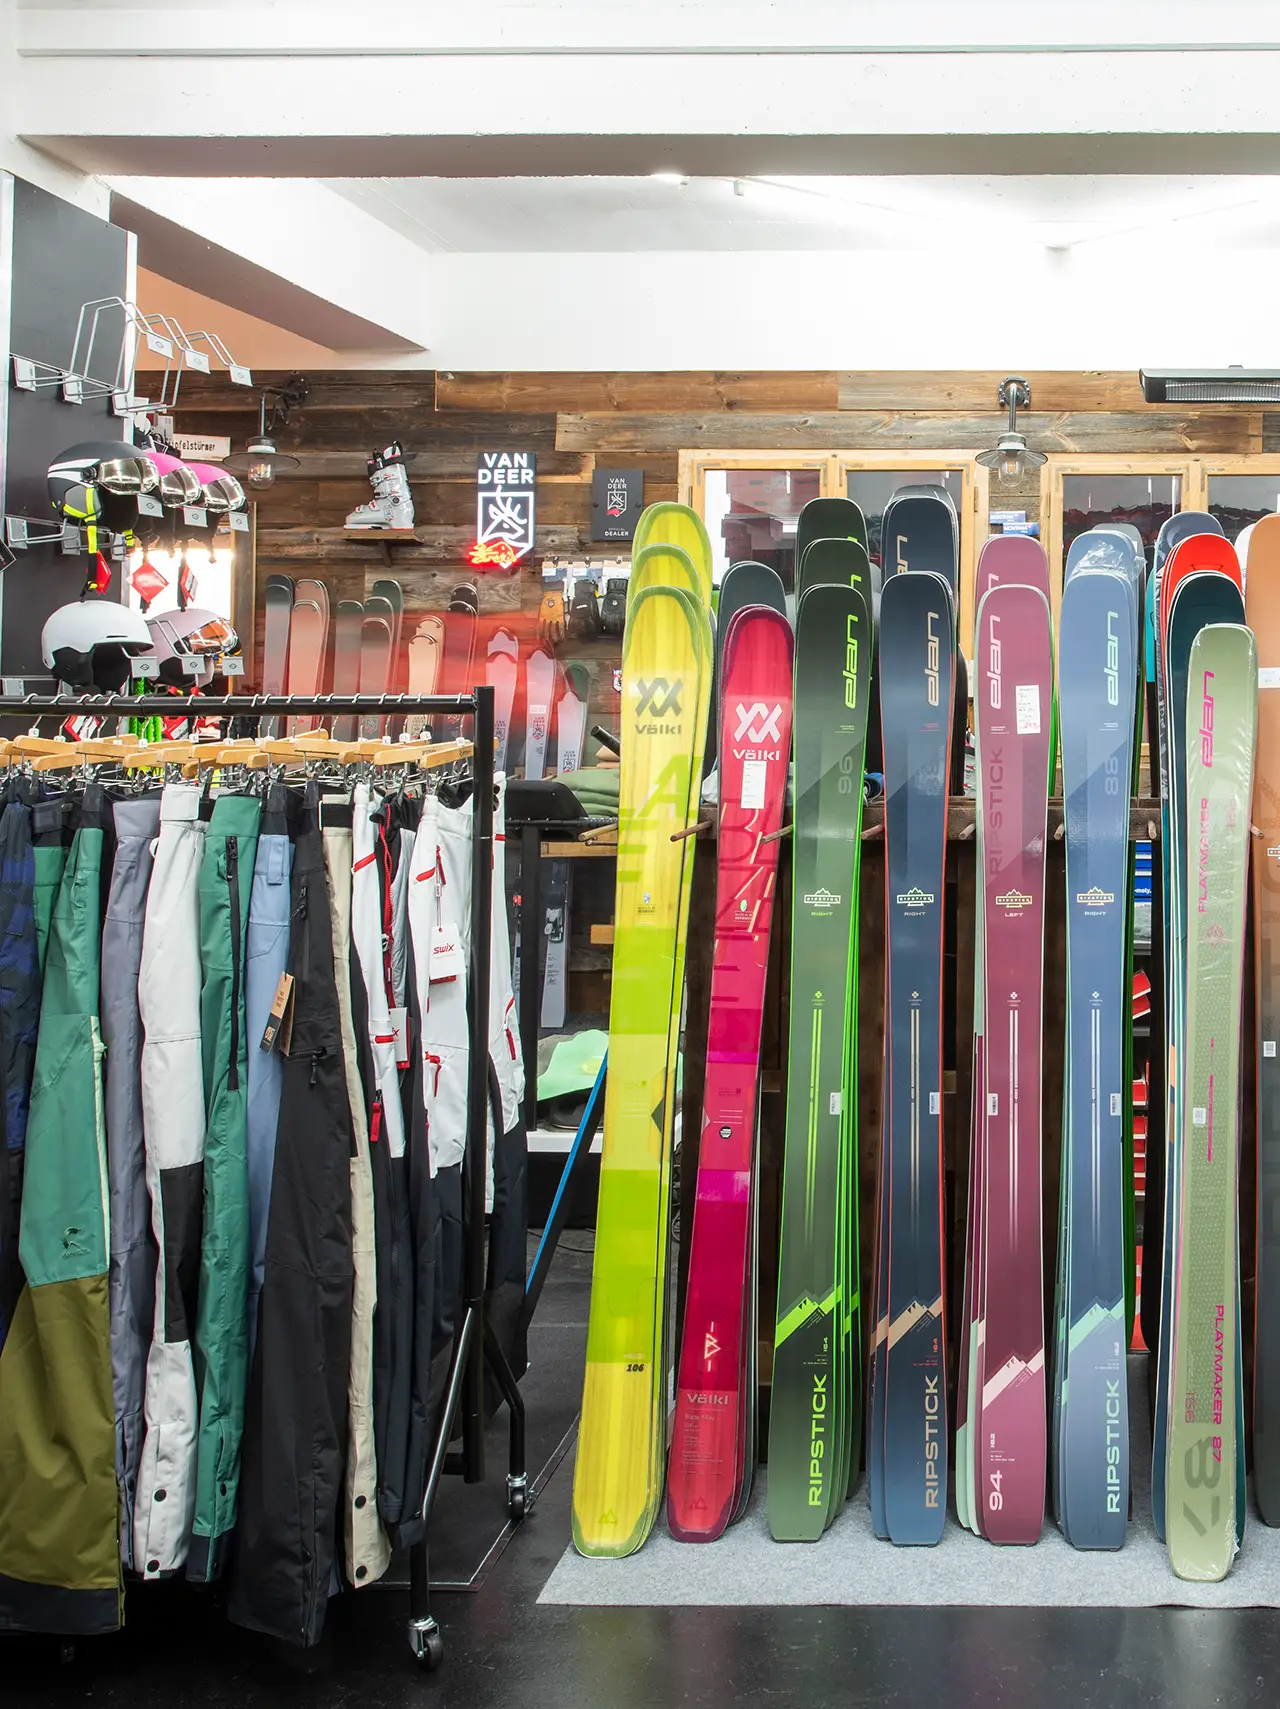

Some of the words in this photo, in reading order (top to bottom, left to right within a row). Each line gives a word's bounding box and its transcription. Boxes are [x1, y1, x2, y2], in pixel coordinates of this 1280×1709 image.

[169, 440, 215, 451] ipfelstürmer
[483, 453, 527, 468] VAN
[478, 469, 534, 484] DEER
[843, 614, 858, 710] elan
[924, 611, 939, 707] elan
[985, 614, 1001, 710] elan
[1103, 611, 1118, 707] elan
[634, 723, 682, 735] Völkl
[1199, 670, 1215, 768] elan
[732, 748, 780, 761] Völkl
[838, 755, 852, 794] 96
[1103, 756, 1119, 796] 88
[1198, 797, 1209, 913] PLAYMAKER
[626, 1363, 644, 1373] 106
[1212, 1304, 1225, 1426] PLAYMAKER
[686, 1392, 729, 1405] Völkl
[808, 1374, 828, 1507] RIPSTICK
[925, 1374, 938, 1509] RIPSTICK
[1107, 1379, 1120, 1513] RIPSTICK
[1212, 1436, 1223, 1464] 87
[989, 1470, 1003, 1511] 94
